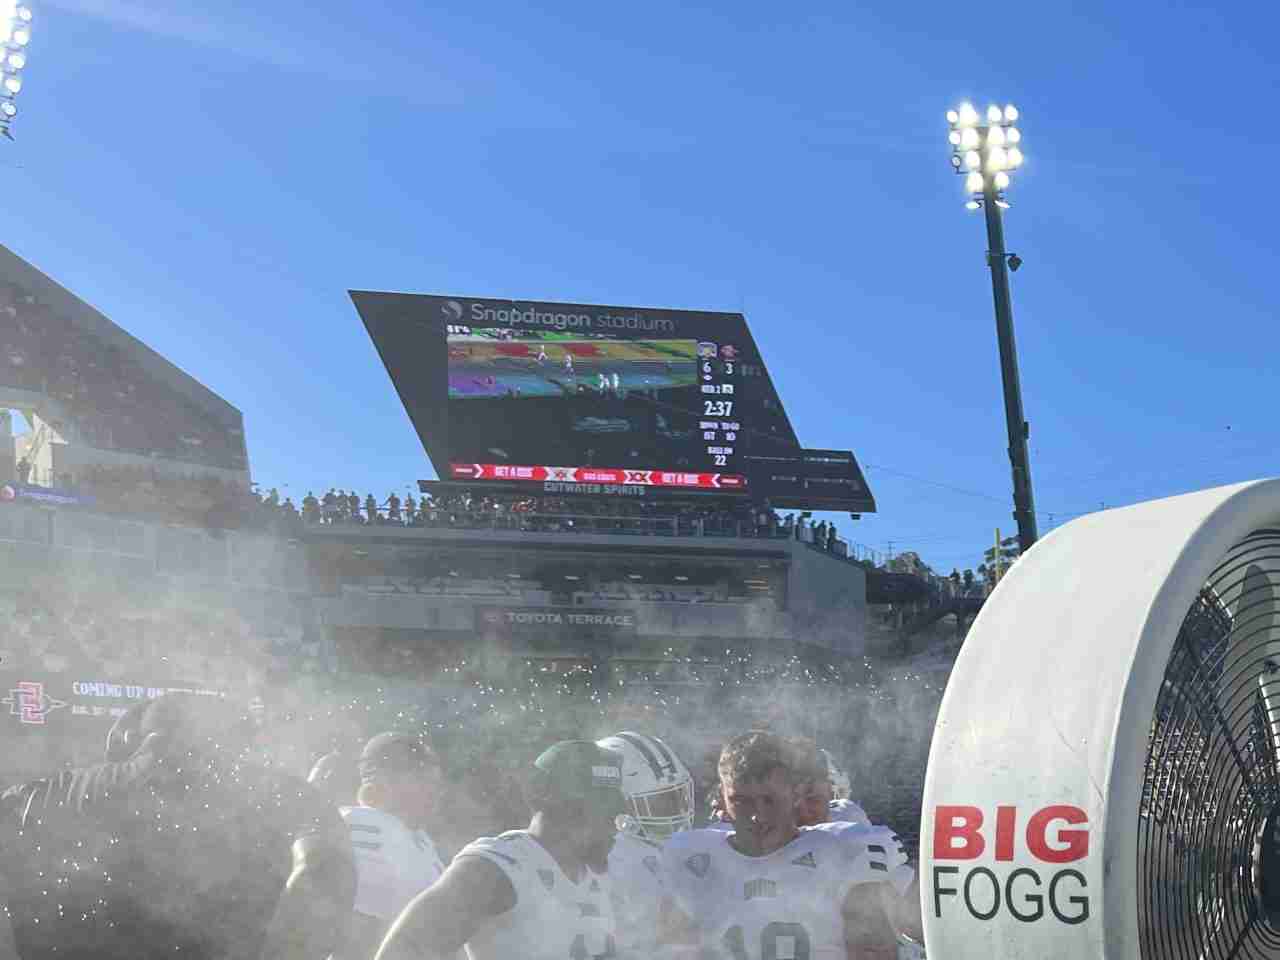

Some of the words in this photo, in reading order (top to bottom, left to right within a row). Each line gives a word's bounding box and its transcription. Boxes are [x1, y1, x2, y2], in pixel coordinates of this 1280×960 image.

[471, 304, 591, 329] Snapdragon
[598, 311, 674, 332] stadium
[703, 362, 712, 373] 6
[725, 363, 734, 375] 3
[704, 401, 733, 417] 2:37
[715, 455, 728, 466] 22
[604, 484, 645, 496] SPIRITS
[504, 612, 562, 624] TOYOTA
[567, 614, 633, 626] TERRACE
[932, 805, 1090, 863] BIG
[932, 865, 1090, 925] FOGG
